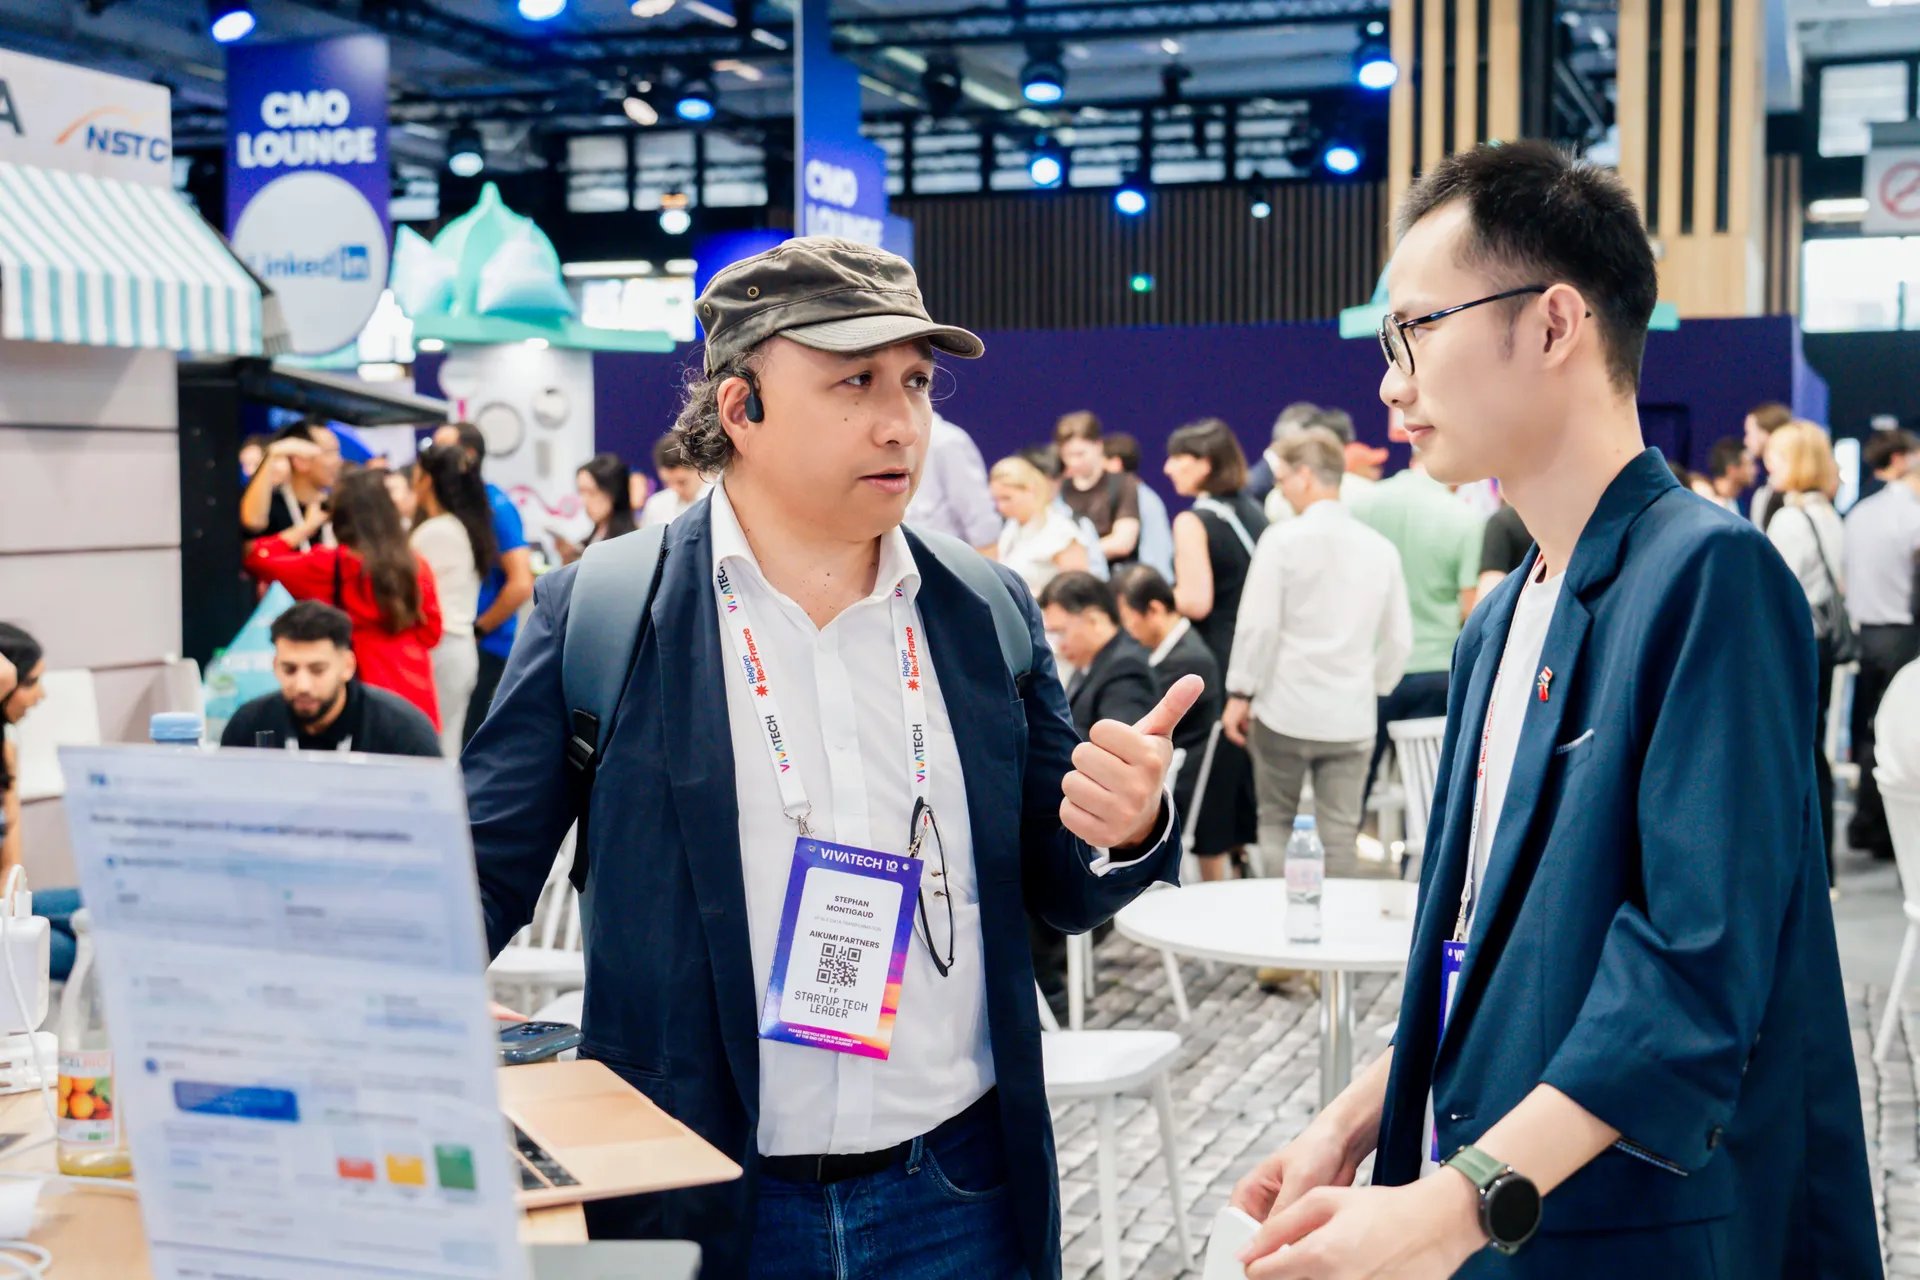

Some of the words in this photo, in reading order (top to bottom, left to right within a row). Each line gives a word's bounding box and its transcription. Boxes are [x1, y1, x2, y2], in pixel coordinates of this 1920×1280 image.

[261, 88, 350, 129] CMO
[86, 125, 170, 162] NSTC
[236, 126, 377, 169] LOUNGE
[805, 159, 858, 208] CMO
[764, 714, 790, 773] VIVATECH
[912, 724, 926, 783] VIVATECH
[820, 847, 883, 870] VIVATECH
[826, 904, 874, 919] MONTIGAUD
[834, 895, 870, 907] STEPHAN
[809, 930, 838, 941] AIKUMI
[838, 935, 880, 949] PARTNERS
[794, 990, 840, 1006] STARTUP
[843, 998, 868, 1012] TECH
[809, 1003, 848, 1019] LEADER
